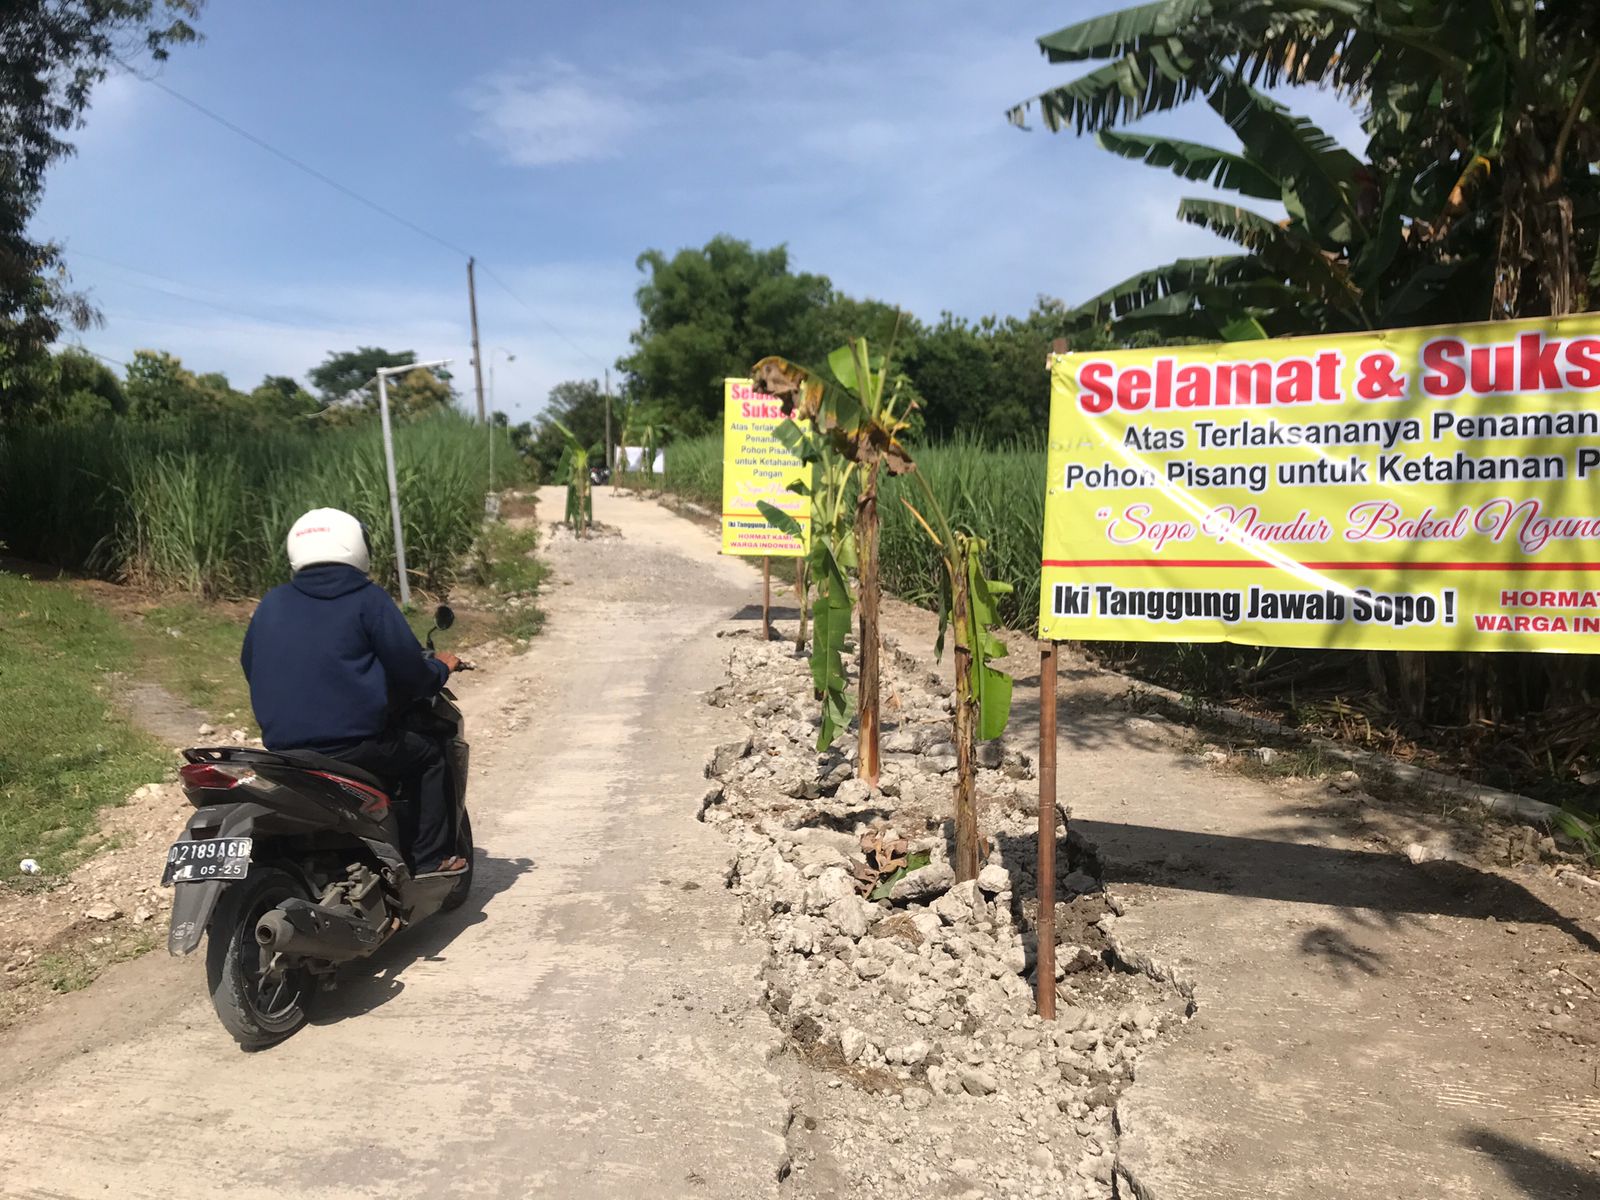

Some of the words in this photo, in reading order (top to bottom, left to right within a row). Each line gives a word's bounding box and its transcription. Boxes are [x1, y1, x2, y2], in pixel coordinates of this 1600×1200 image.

[1080, 352, 1342, 413] Selamat
[1357, 354, 1405, 399] &
[1423, 333, 1600, 396] Suks
[1124, 426, 1185, 450] Atas
[1195, 419, 1420, 448] Terlaksananya
[1433, 412, 1598, 439] Penaman
[753, 469, 783, 479] Pangan
[1066, 463, 1155, 489] Pohon
[1168, 461, 1267, 491] Pisang
[1279, 456, 1367, 486] untuk
[1380, 452, 1564, 482] Ketahanan
[1345, 501, 1468, 540] Bakal
[759, 542, 802, 550] INDONESIA
[1054, 585, 1089, 614] Iki
[1096, 585, 1241, 621] Tanggung
[1248, 587, 1345, 621] Jawab
[1353, 589, 1436, 625] Sopo
[1475, 616, 1568, 633] WARGA
[1574, 616, 1600, 633] IN
[180, 843, 216, 860] 2189
